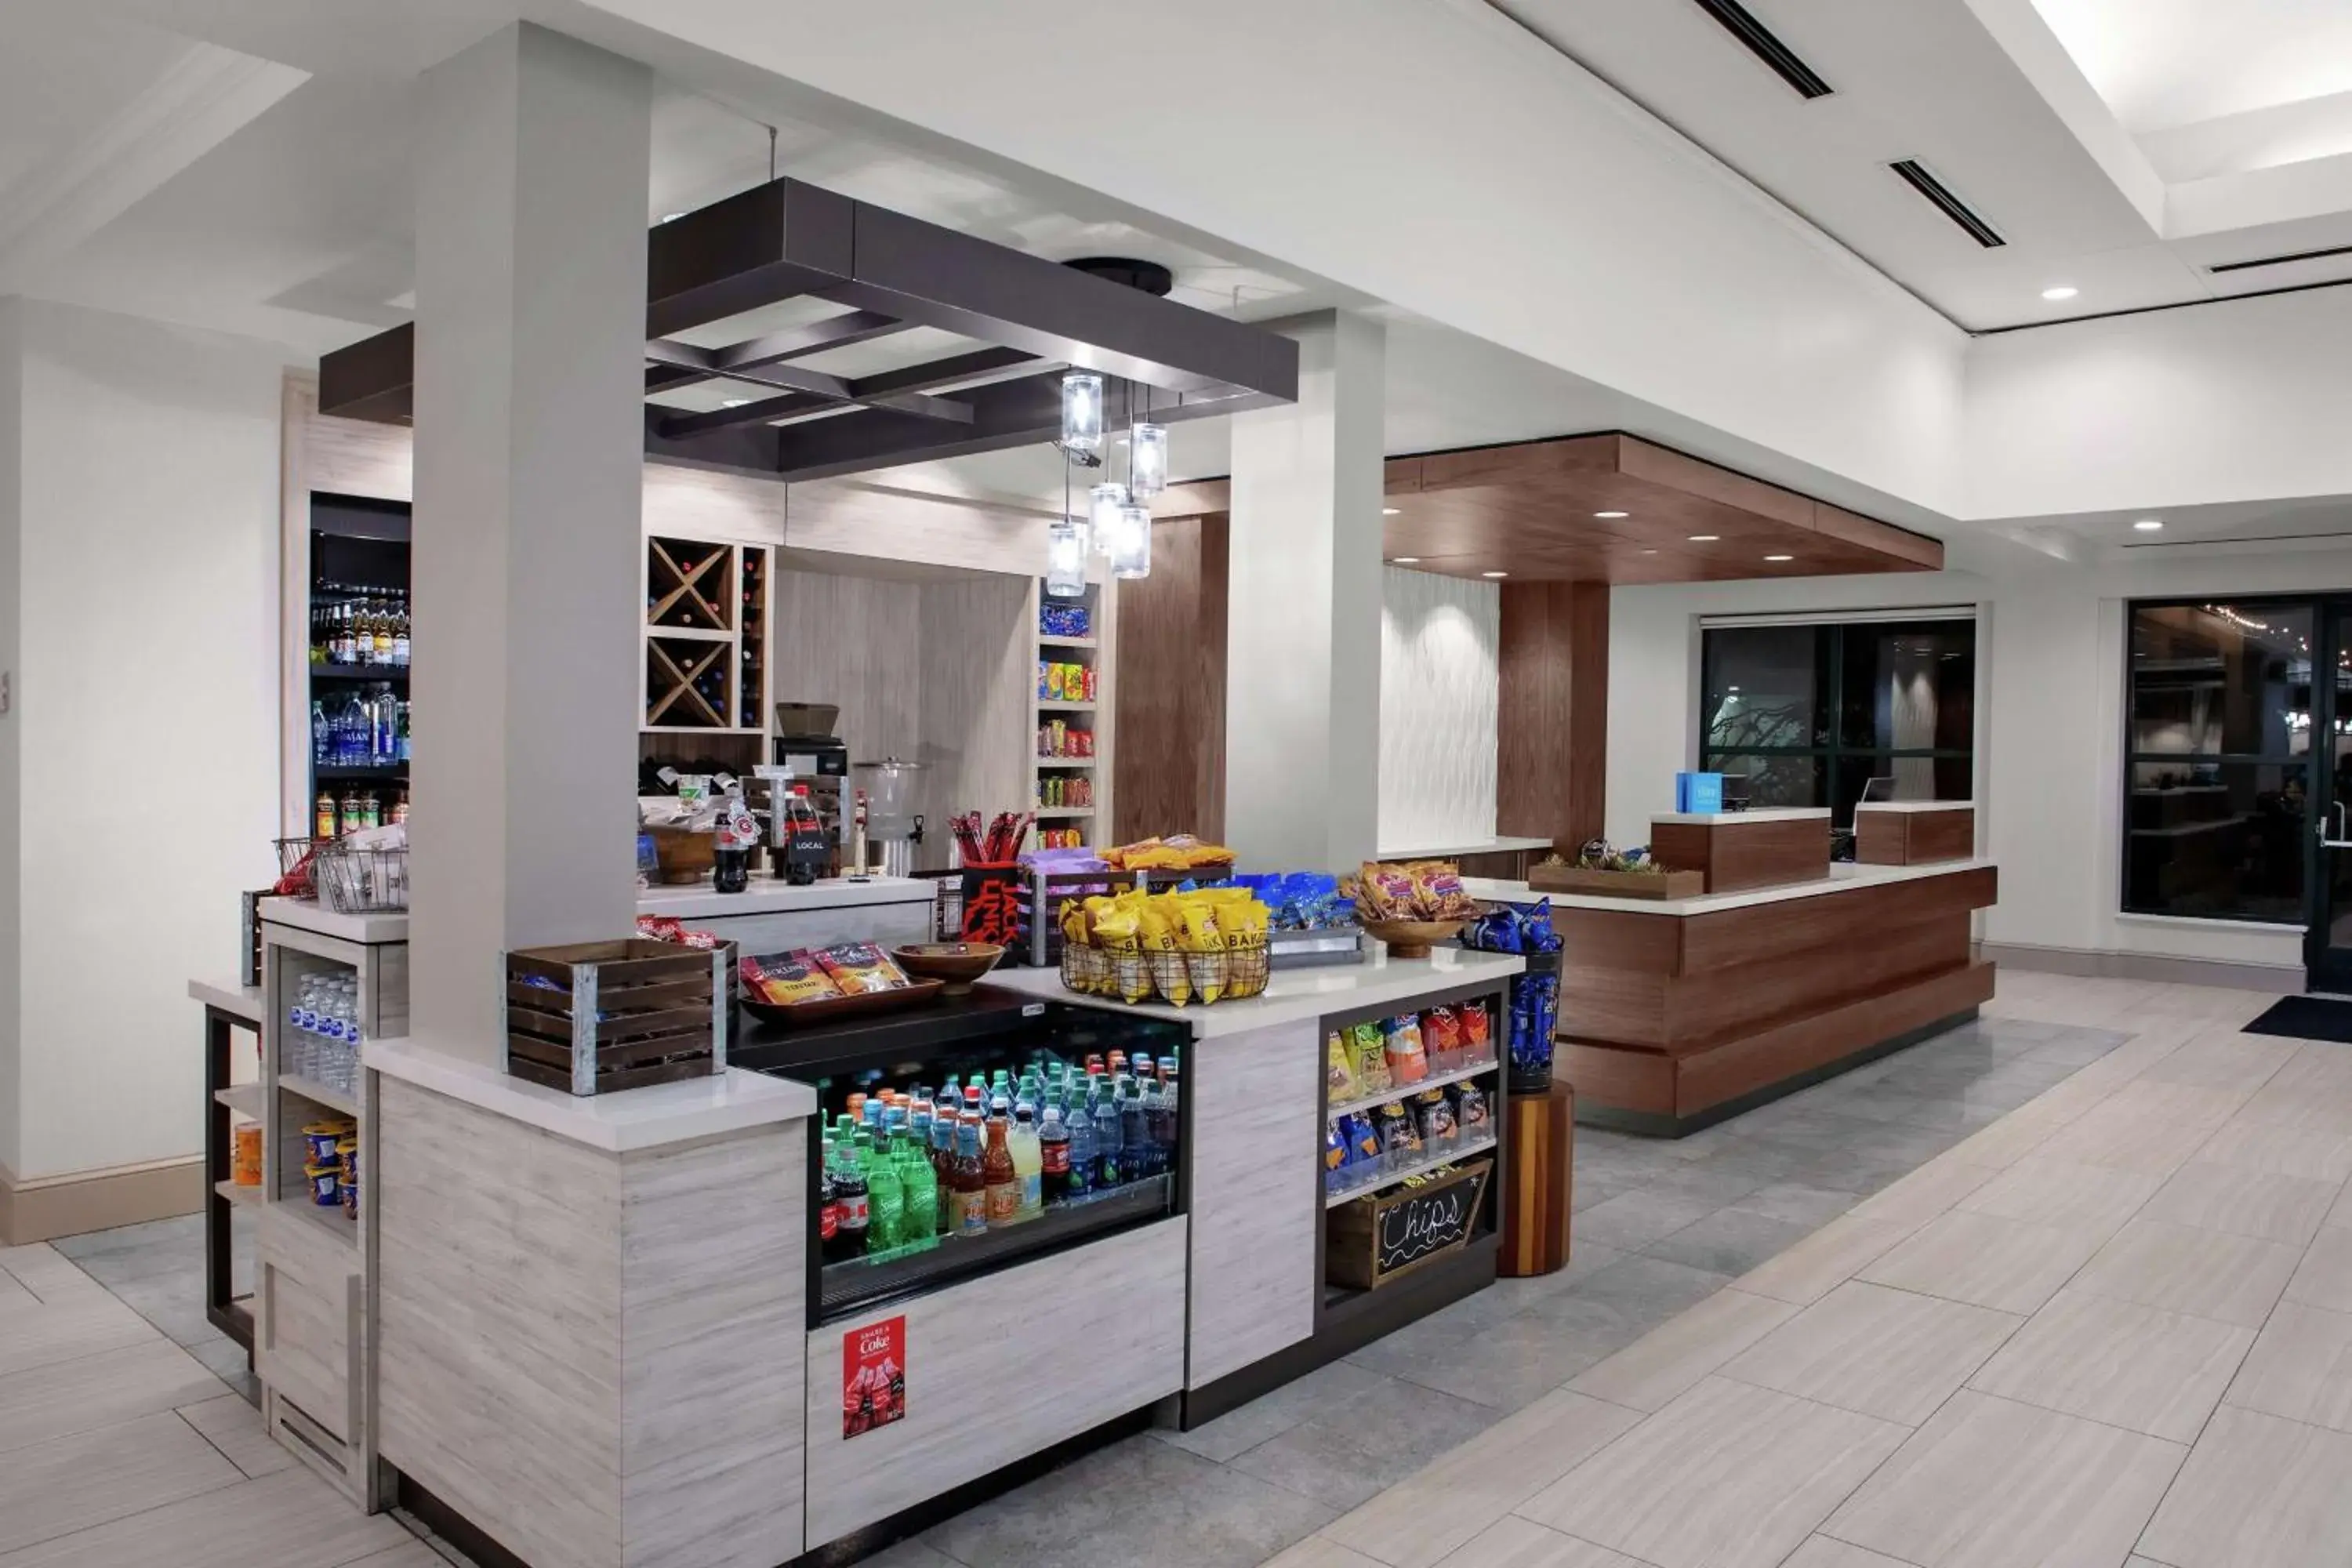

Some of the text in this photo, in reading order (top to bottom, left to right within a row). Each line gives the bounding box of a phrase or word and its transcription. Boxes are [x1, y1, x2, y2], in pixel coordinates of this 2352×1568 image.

[796, 841, 825, 850] LOCAL
[1384, 1192, 1465, 1250] Chips
[860, 1335, 891, 1354] Coke
